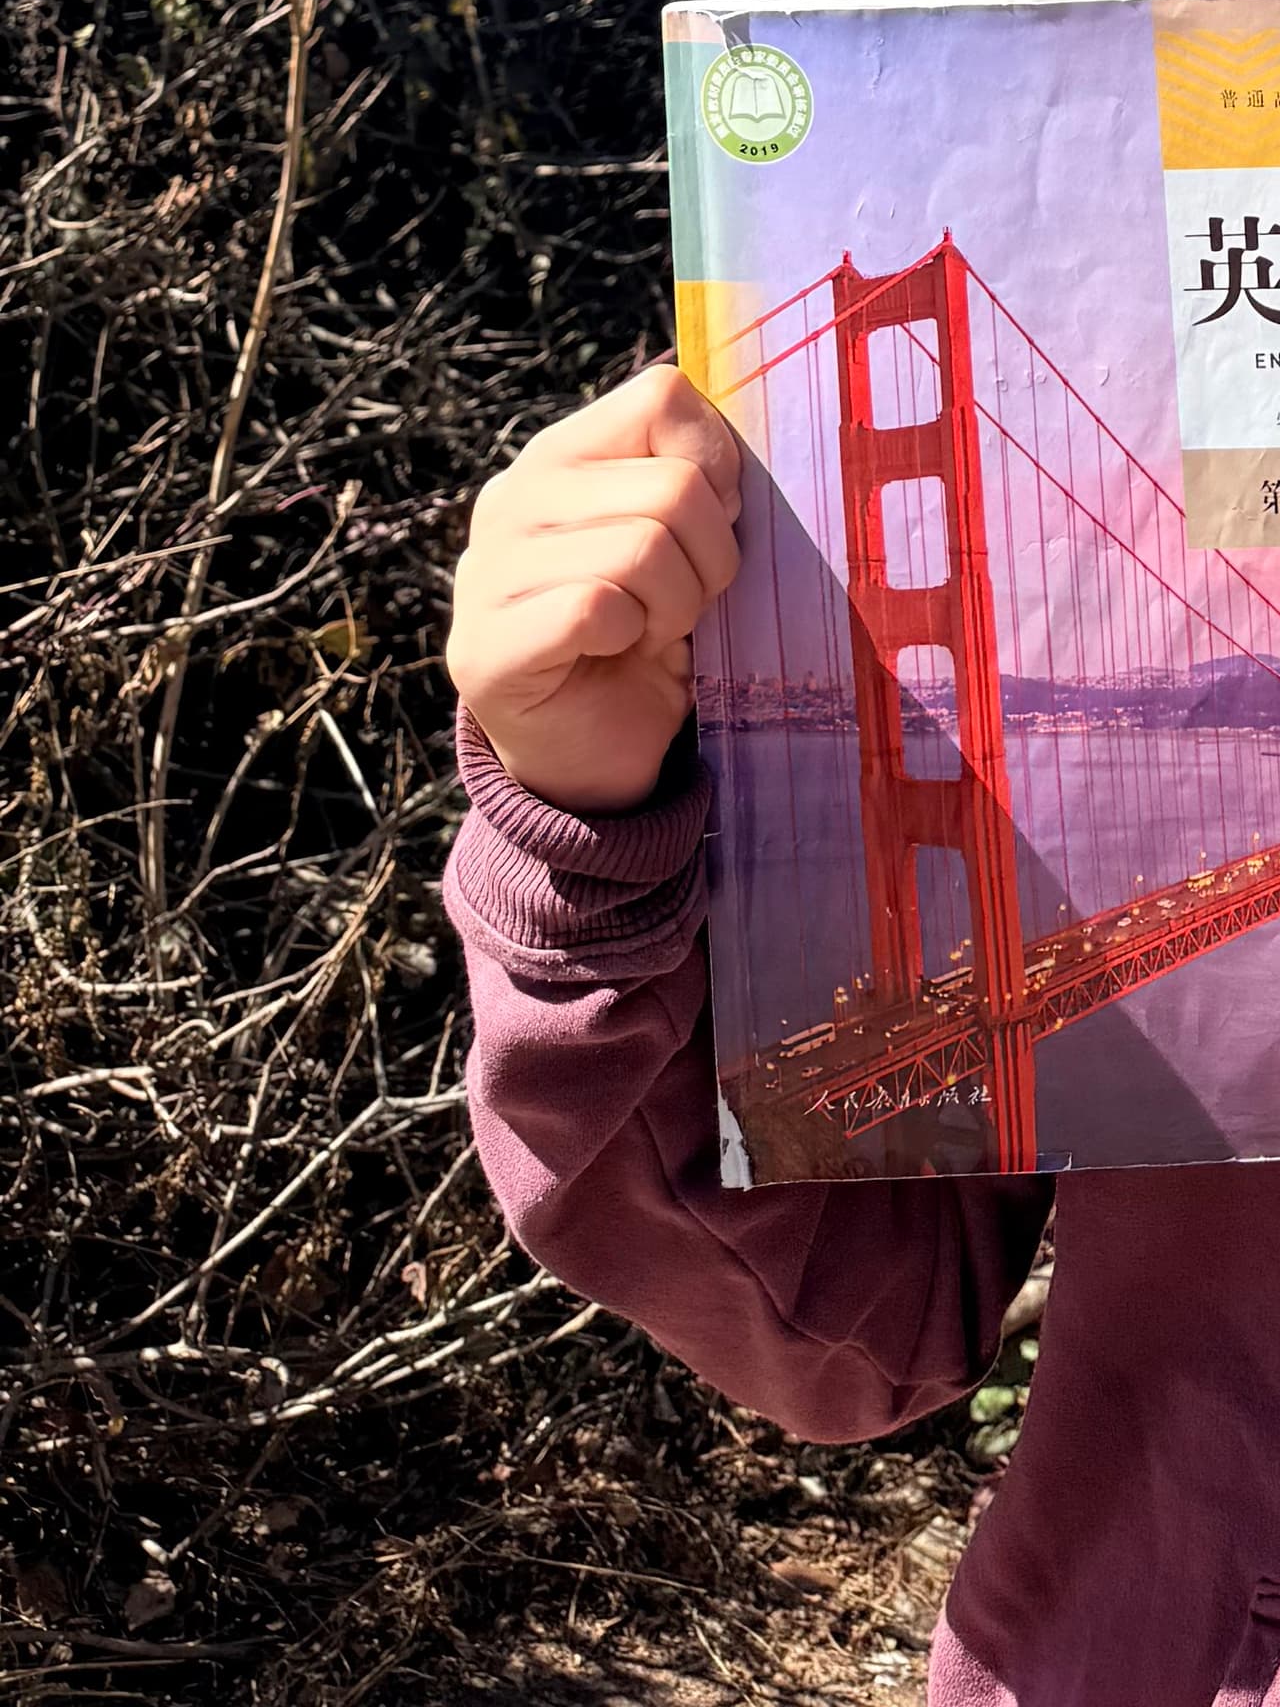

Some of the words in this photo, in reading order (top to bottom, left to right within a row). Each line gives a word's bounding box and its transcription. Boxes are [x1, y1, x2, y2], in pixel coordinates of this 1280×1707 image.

[739, 143, 779, 156] 2019
[804, 1084, 992, 1115] 人民教育出版社
